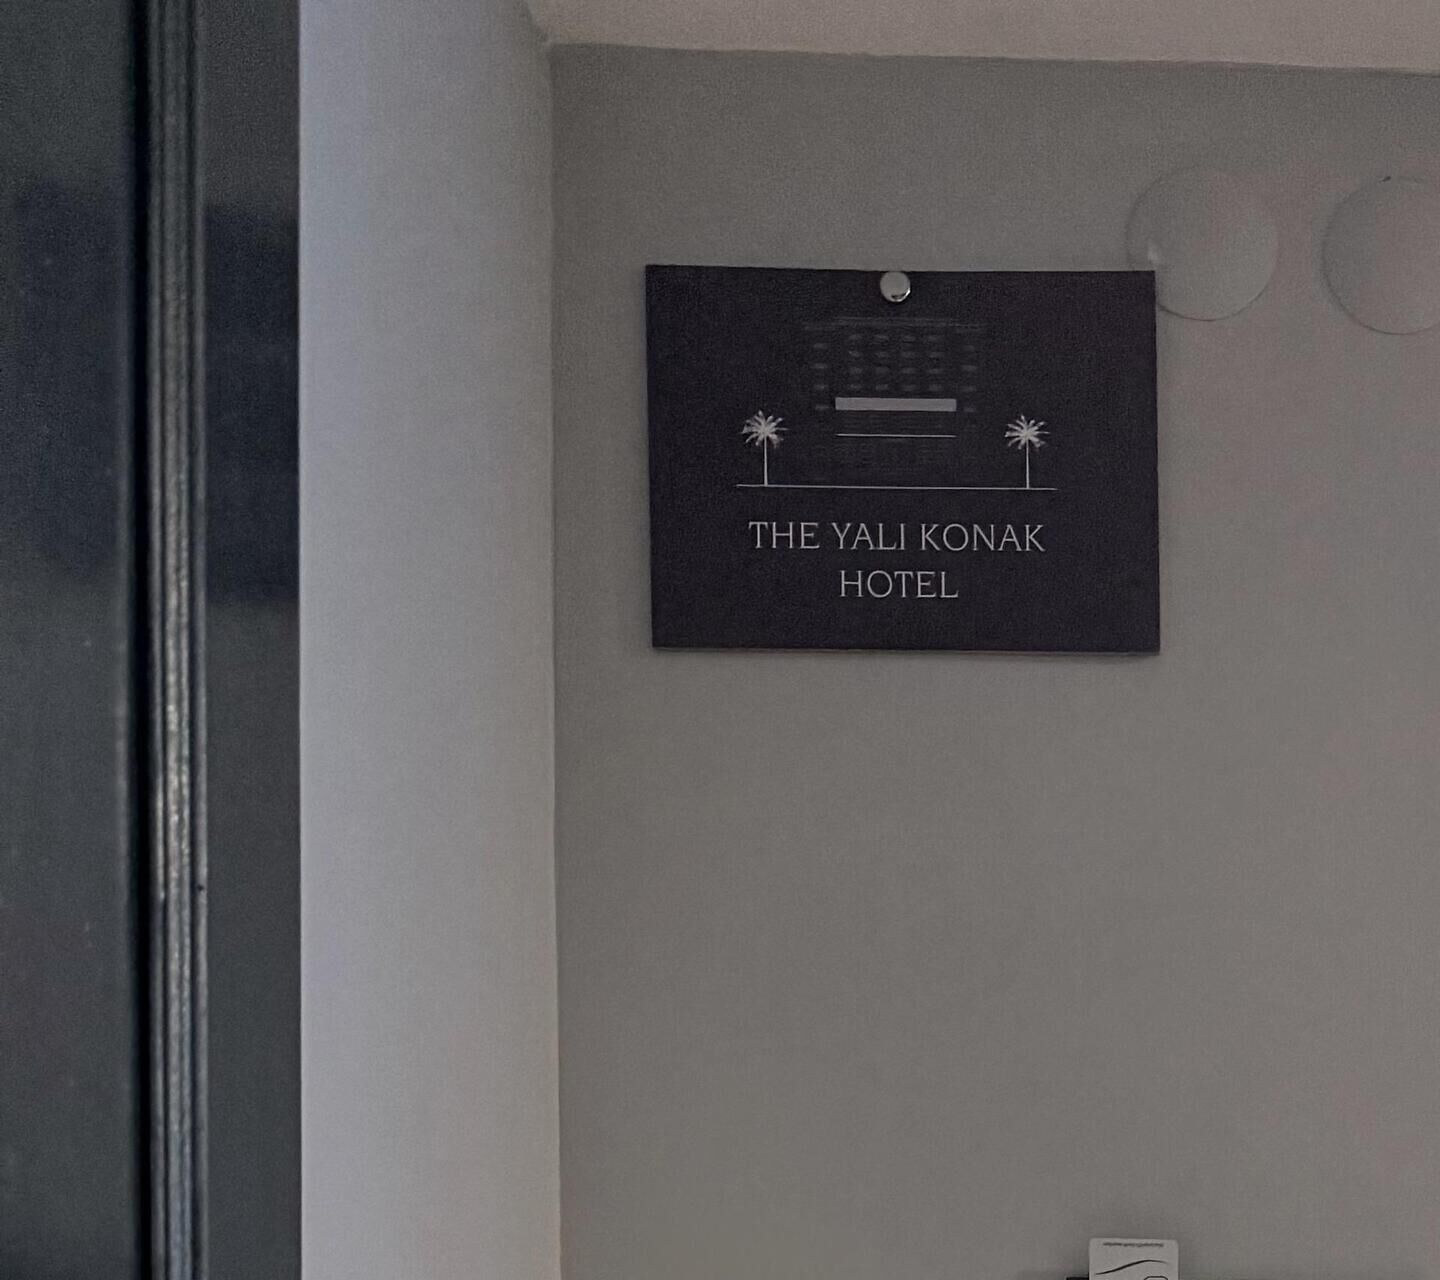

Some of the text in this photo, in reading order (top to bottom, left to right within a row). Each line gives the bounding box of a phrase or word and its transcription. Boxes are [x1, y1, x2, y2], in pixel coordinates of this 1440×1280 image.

[748, 521, 1046, 552] THE YALI KONAK
[840, 570, 959, 598] HOTEL
